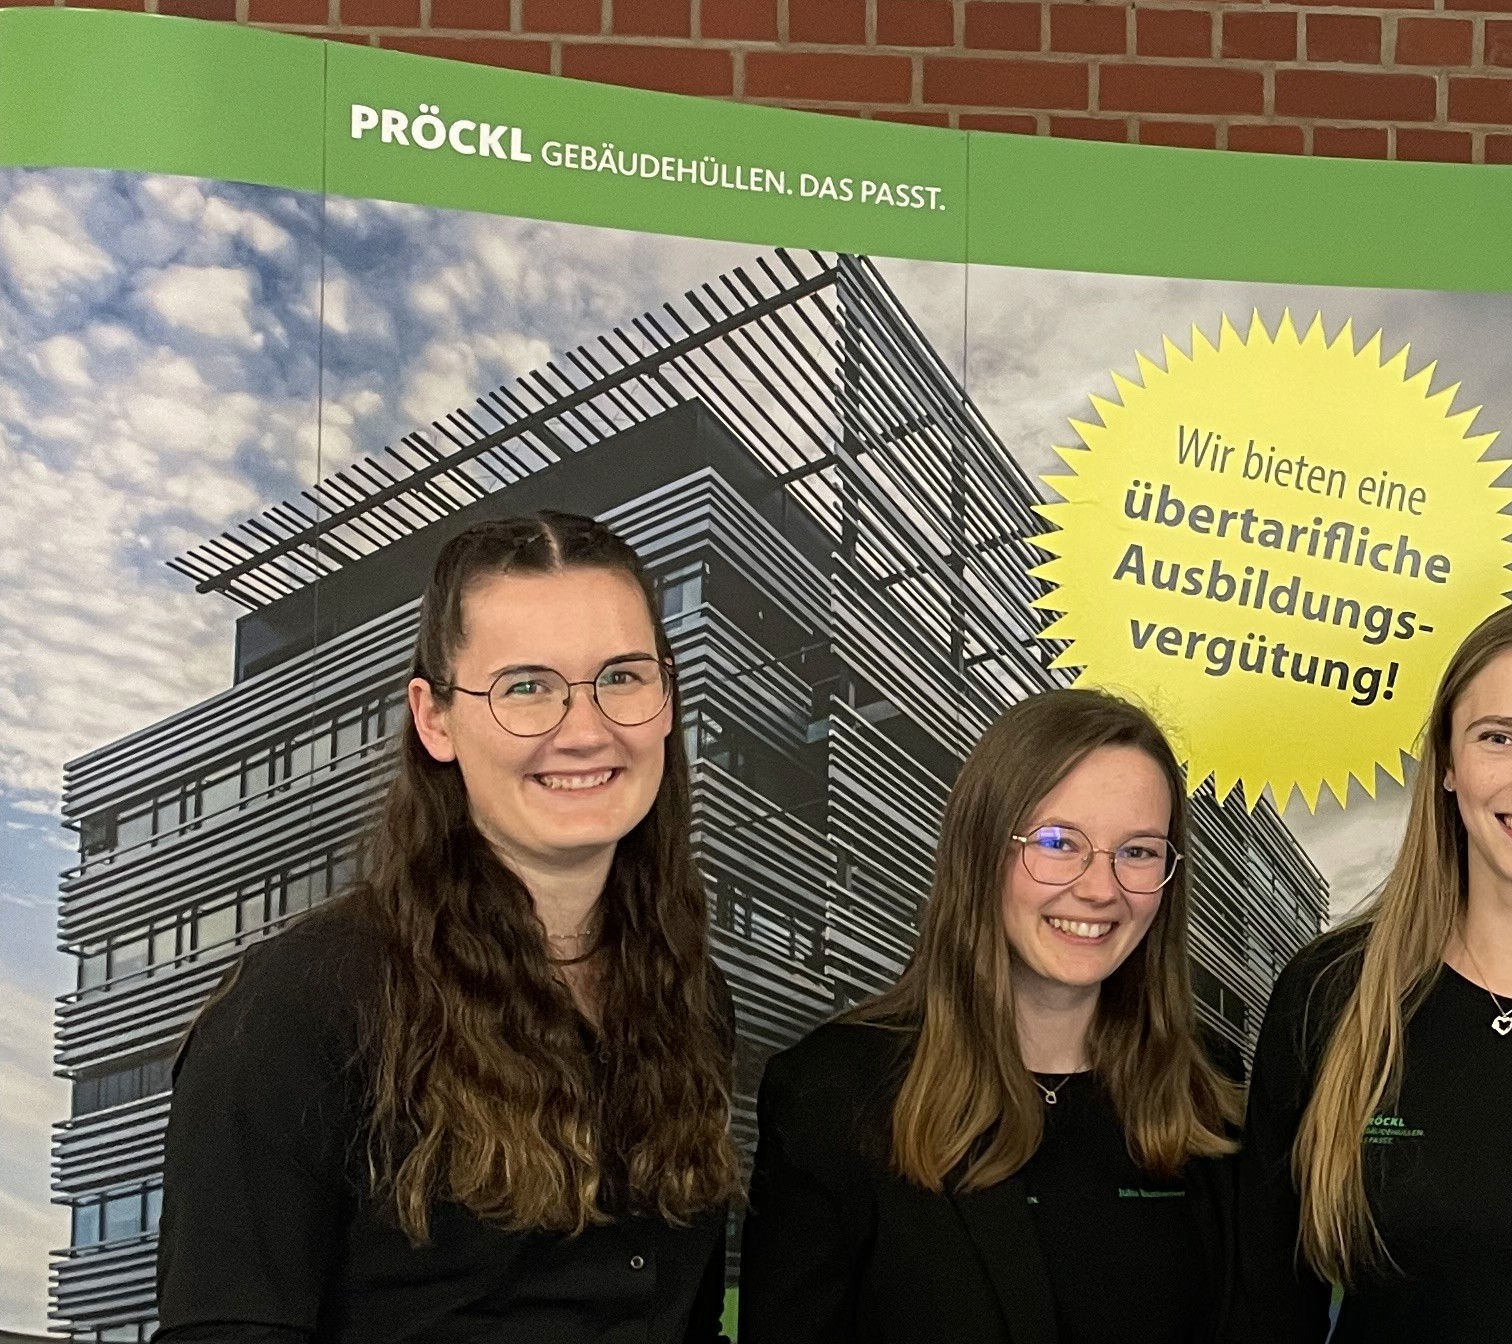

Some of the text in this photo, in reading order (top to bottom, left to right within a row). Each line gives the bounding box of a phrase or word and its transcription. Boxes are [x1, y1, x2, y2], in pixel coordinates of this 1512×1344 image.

[351, 103, 946, 211] PRÖCKL GEBÄUDEHÜLLEN. DAS PASST.
[1177, 425, 1426, 515] Wir bieten eine
[1124, 480, 1451, 583] übertarifliche
[1113, 544, 1434, 645] Ausbildungs-
[1131, 619, 1399, 706] vergütung!
